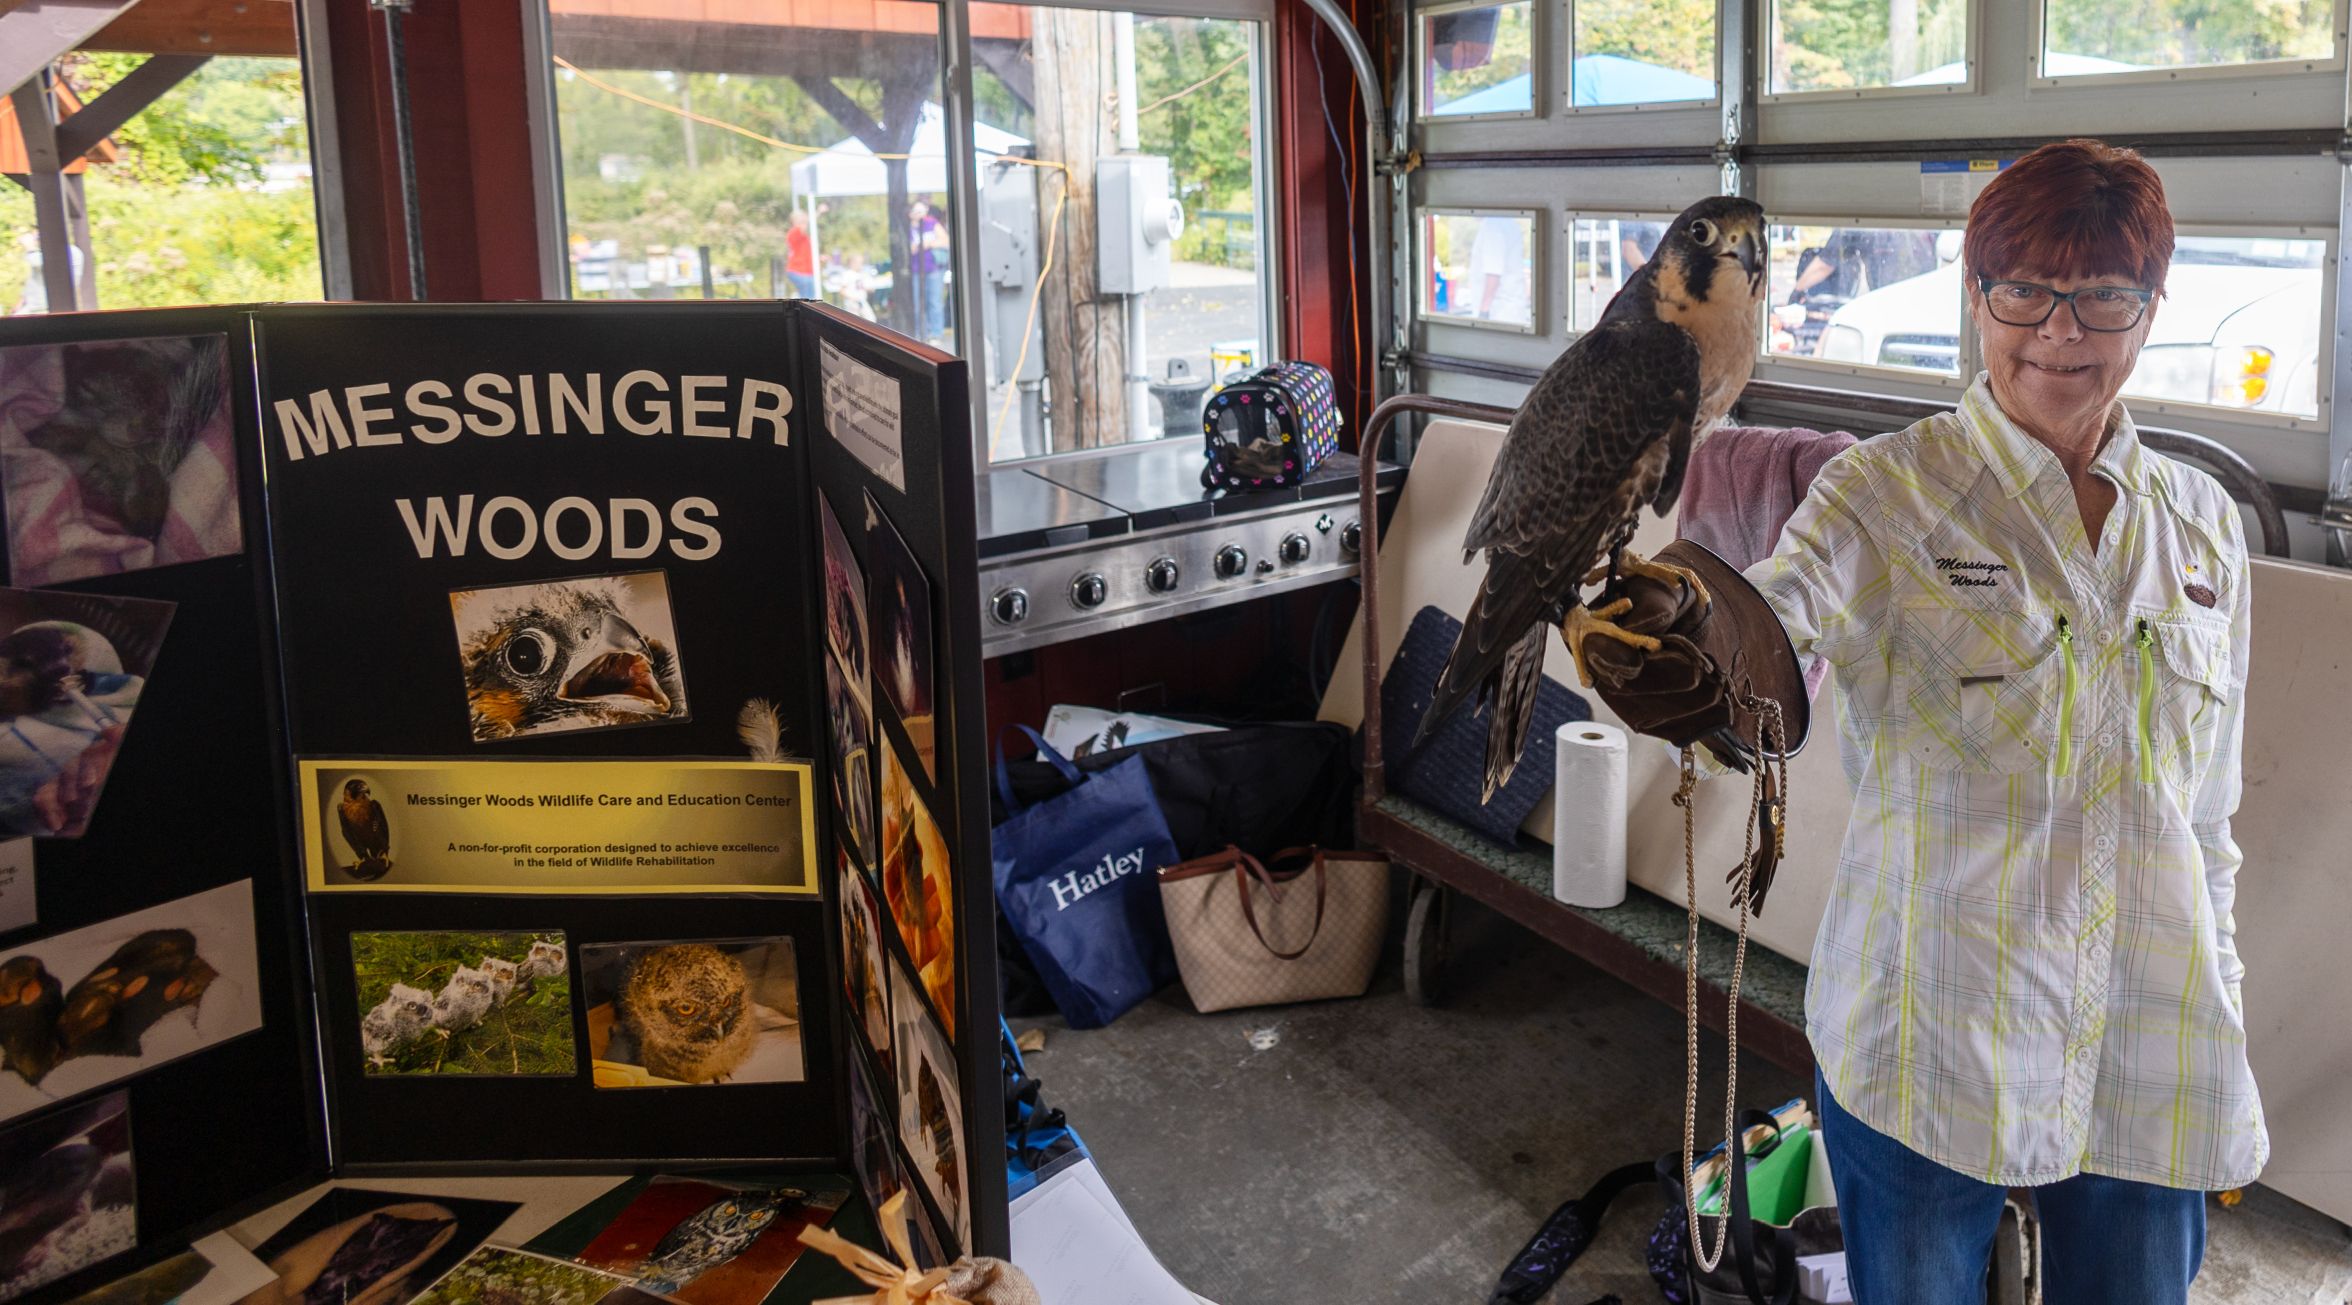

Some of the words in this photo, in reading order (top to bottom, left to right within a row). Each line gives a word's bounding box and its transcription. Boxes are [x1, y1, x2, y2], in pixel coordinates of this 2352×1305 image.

[274, 369, 794, 461] MESSINGER
[395, 494, 722, 560] WOODS
[1936, 557, 2008, 574] Messinger
[1949, 574, 1998, 587] Woods
[407, 794, 481, 808] Messinger
[485, 794, 534, 807] Woods
[539, 794, 594, 807] Wildlife
[598, 794, 631, 806] Care
[636, 794, 663, 806] and
[668, 794, 741, 806] Education
[745, 794, 792, 807] Center
[448, 843, 456, 852] A
[459, 843, 532, 855] non-for-profit
[535, 844, 601, 855] corporation
[605, 843, 657, 854] designed
[660, 844, 672, 852] to
[675, 843, 719, 852] achieve
[722, 843, 780, 853] excellence
[514, 857, 524, 867] in
[527, 857, 545, 867] the
[548, 857, 572, 867] field
[576, 857, 587, 867] of
[590, 857, 633, 866] Wildlife
[636, 856, 715, 866] Rehabilitation
[1047, 847, 1144, 911] Hatley
